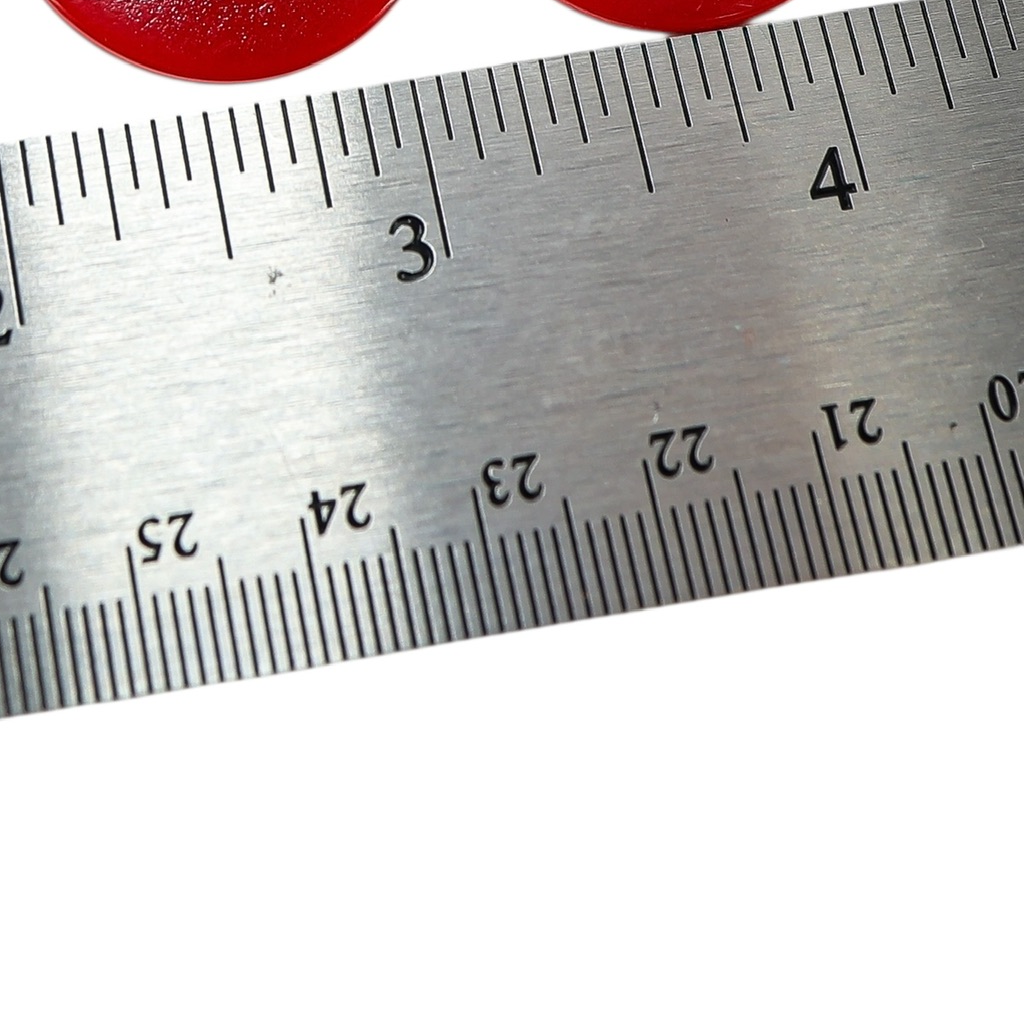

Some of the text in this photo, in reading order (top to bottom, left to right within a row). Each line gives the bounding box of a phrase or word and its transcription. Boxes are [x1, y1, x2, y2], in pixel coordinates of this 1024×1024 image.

[809, 146, 857, 211] 4
[388, 215, 436, 282] 3
[987, 371, 1024, 422] 0
[820, 398, 883, 450] 21
[649, 425, 714, 478] 22
[482, 453, 543, 507] 23
[308, 483, 372, 536] 24
[137, 511, 198, 563] 25
